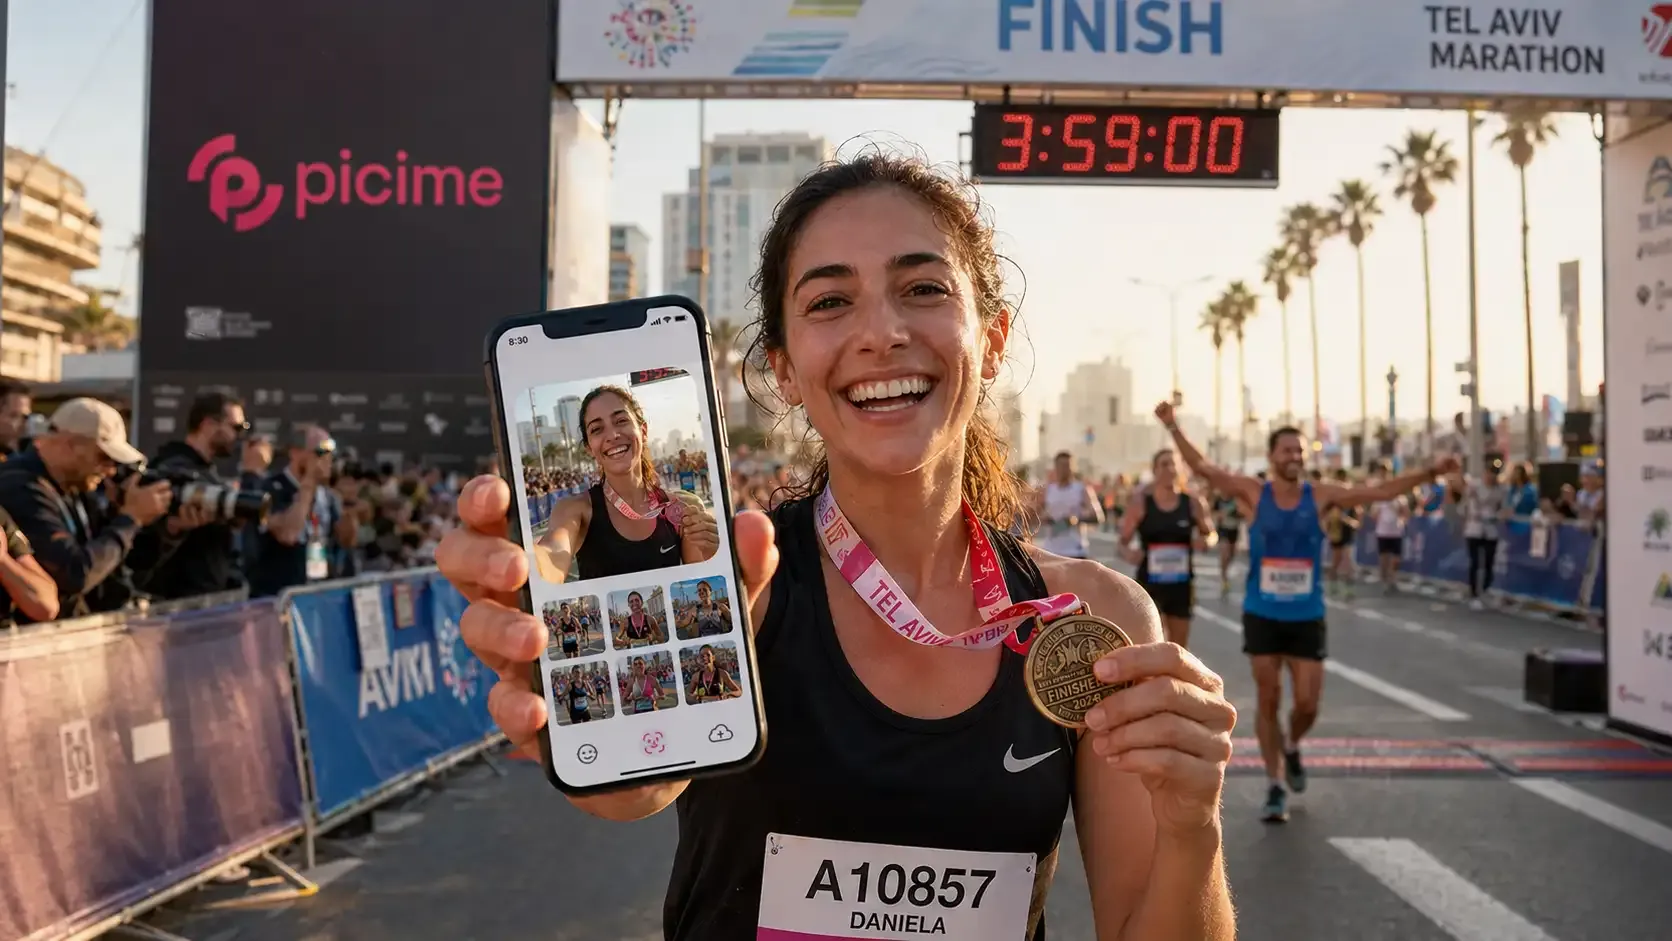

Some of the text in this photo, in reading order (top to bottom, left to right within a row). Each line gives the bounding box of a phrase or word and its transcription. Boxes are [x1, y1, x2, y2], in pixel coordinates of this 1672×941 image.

[998, 0, 1222, 55] FINISH
[1424, 5, 1562, 38] TEL AVIV
[1430, 41, 1605, 74] MARATHON
[998, 114, 1244, 173] 3:59:00
[296, 148, 504, 220] picime
[508, 335, 529, 346] 8:30
[869, 579, 903, 624] TEL
[1048, 675, 1104, 703] FINISHE
[805, 859, 996, 909] A10857
[850, 911, 946, 934] DANIELA
